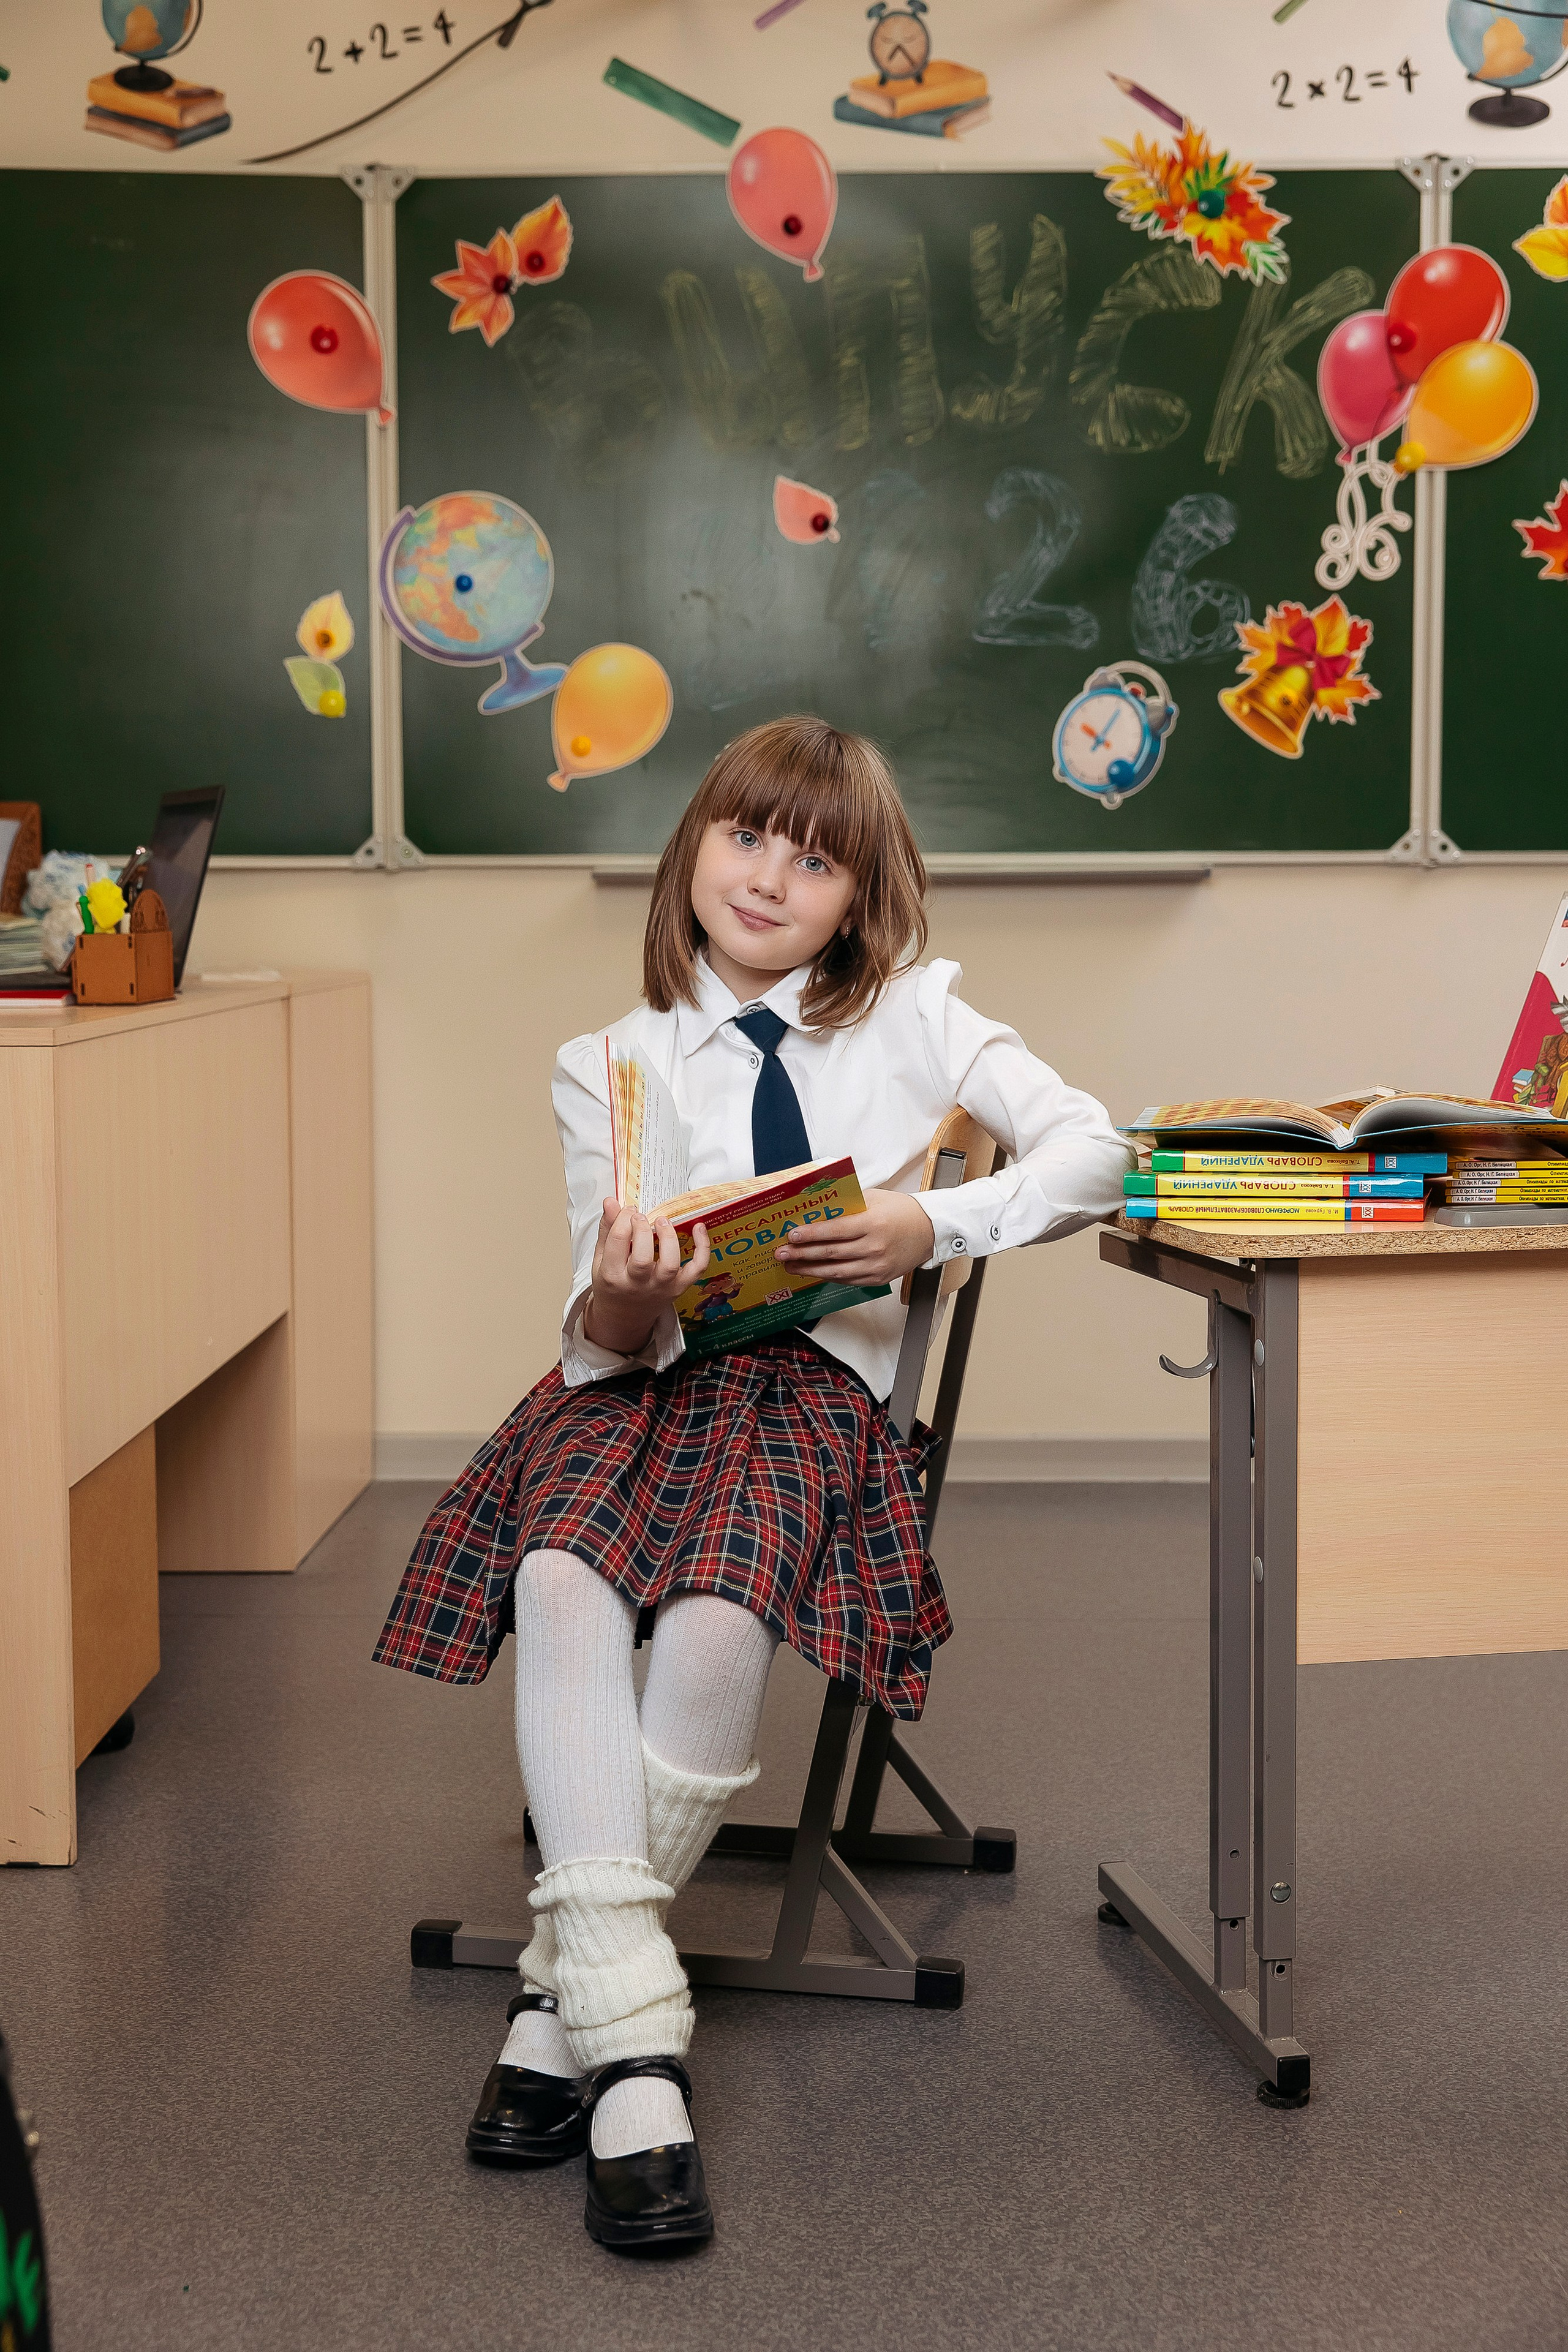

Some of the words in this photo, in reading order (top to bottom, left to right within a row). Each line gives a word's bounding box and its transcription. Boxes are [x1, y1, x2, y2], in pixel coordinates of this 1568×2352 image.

[307, 36, 333, 74] 2
[370, 23, 398, 59] 2
[432, 9, 455, 45] 4
[1272, 71, 1296, 108] 2
[1336, 64, 1362, 102] 2
[1396, 56, 1420, 94] 4
[1200, 1155, 1264, 1166] УДАРЕНИЙ
[1267, 1156, 1322, 1166] СЛОВАРЬ
[1173, 1179, 1237, 1190] УДАРЕНИЙ
[1240, 1181, 1296, 1190] СЛОВАРЬ
[733, 1201, 770, 1218] Виноградова
[734, 1199, 764, 1213] РУССКОГО
[764, 1191, 785, 1201] ЯЗЫКА
[683, 1189, 839, 1255] НВЕРСАЛЬНЫЙ
[733, 1257, 750, 1267] Как
[769, 1290, 790, 1305] XXI
[722, 1334, 755, 1349] классы
